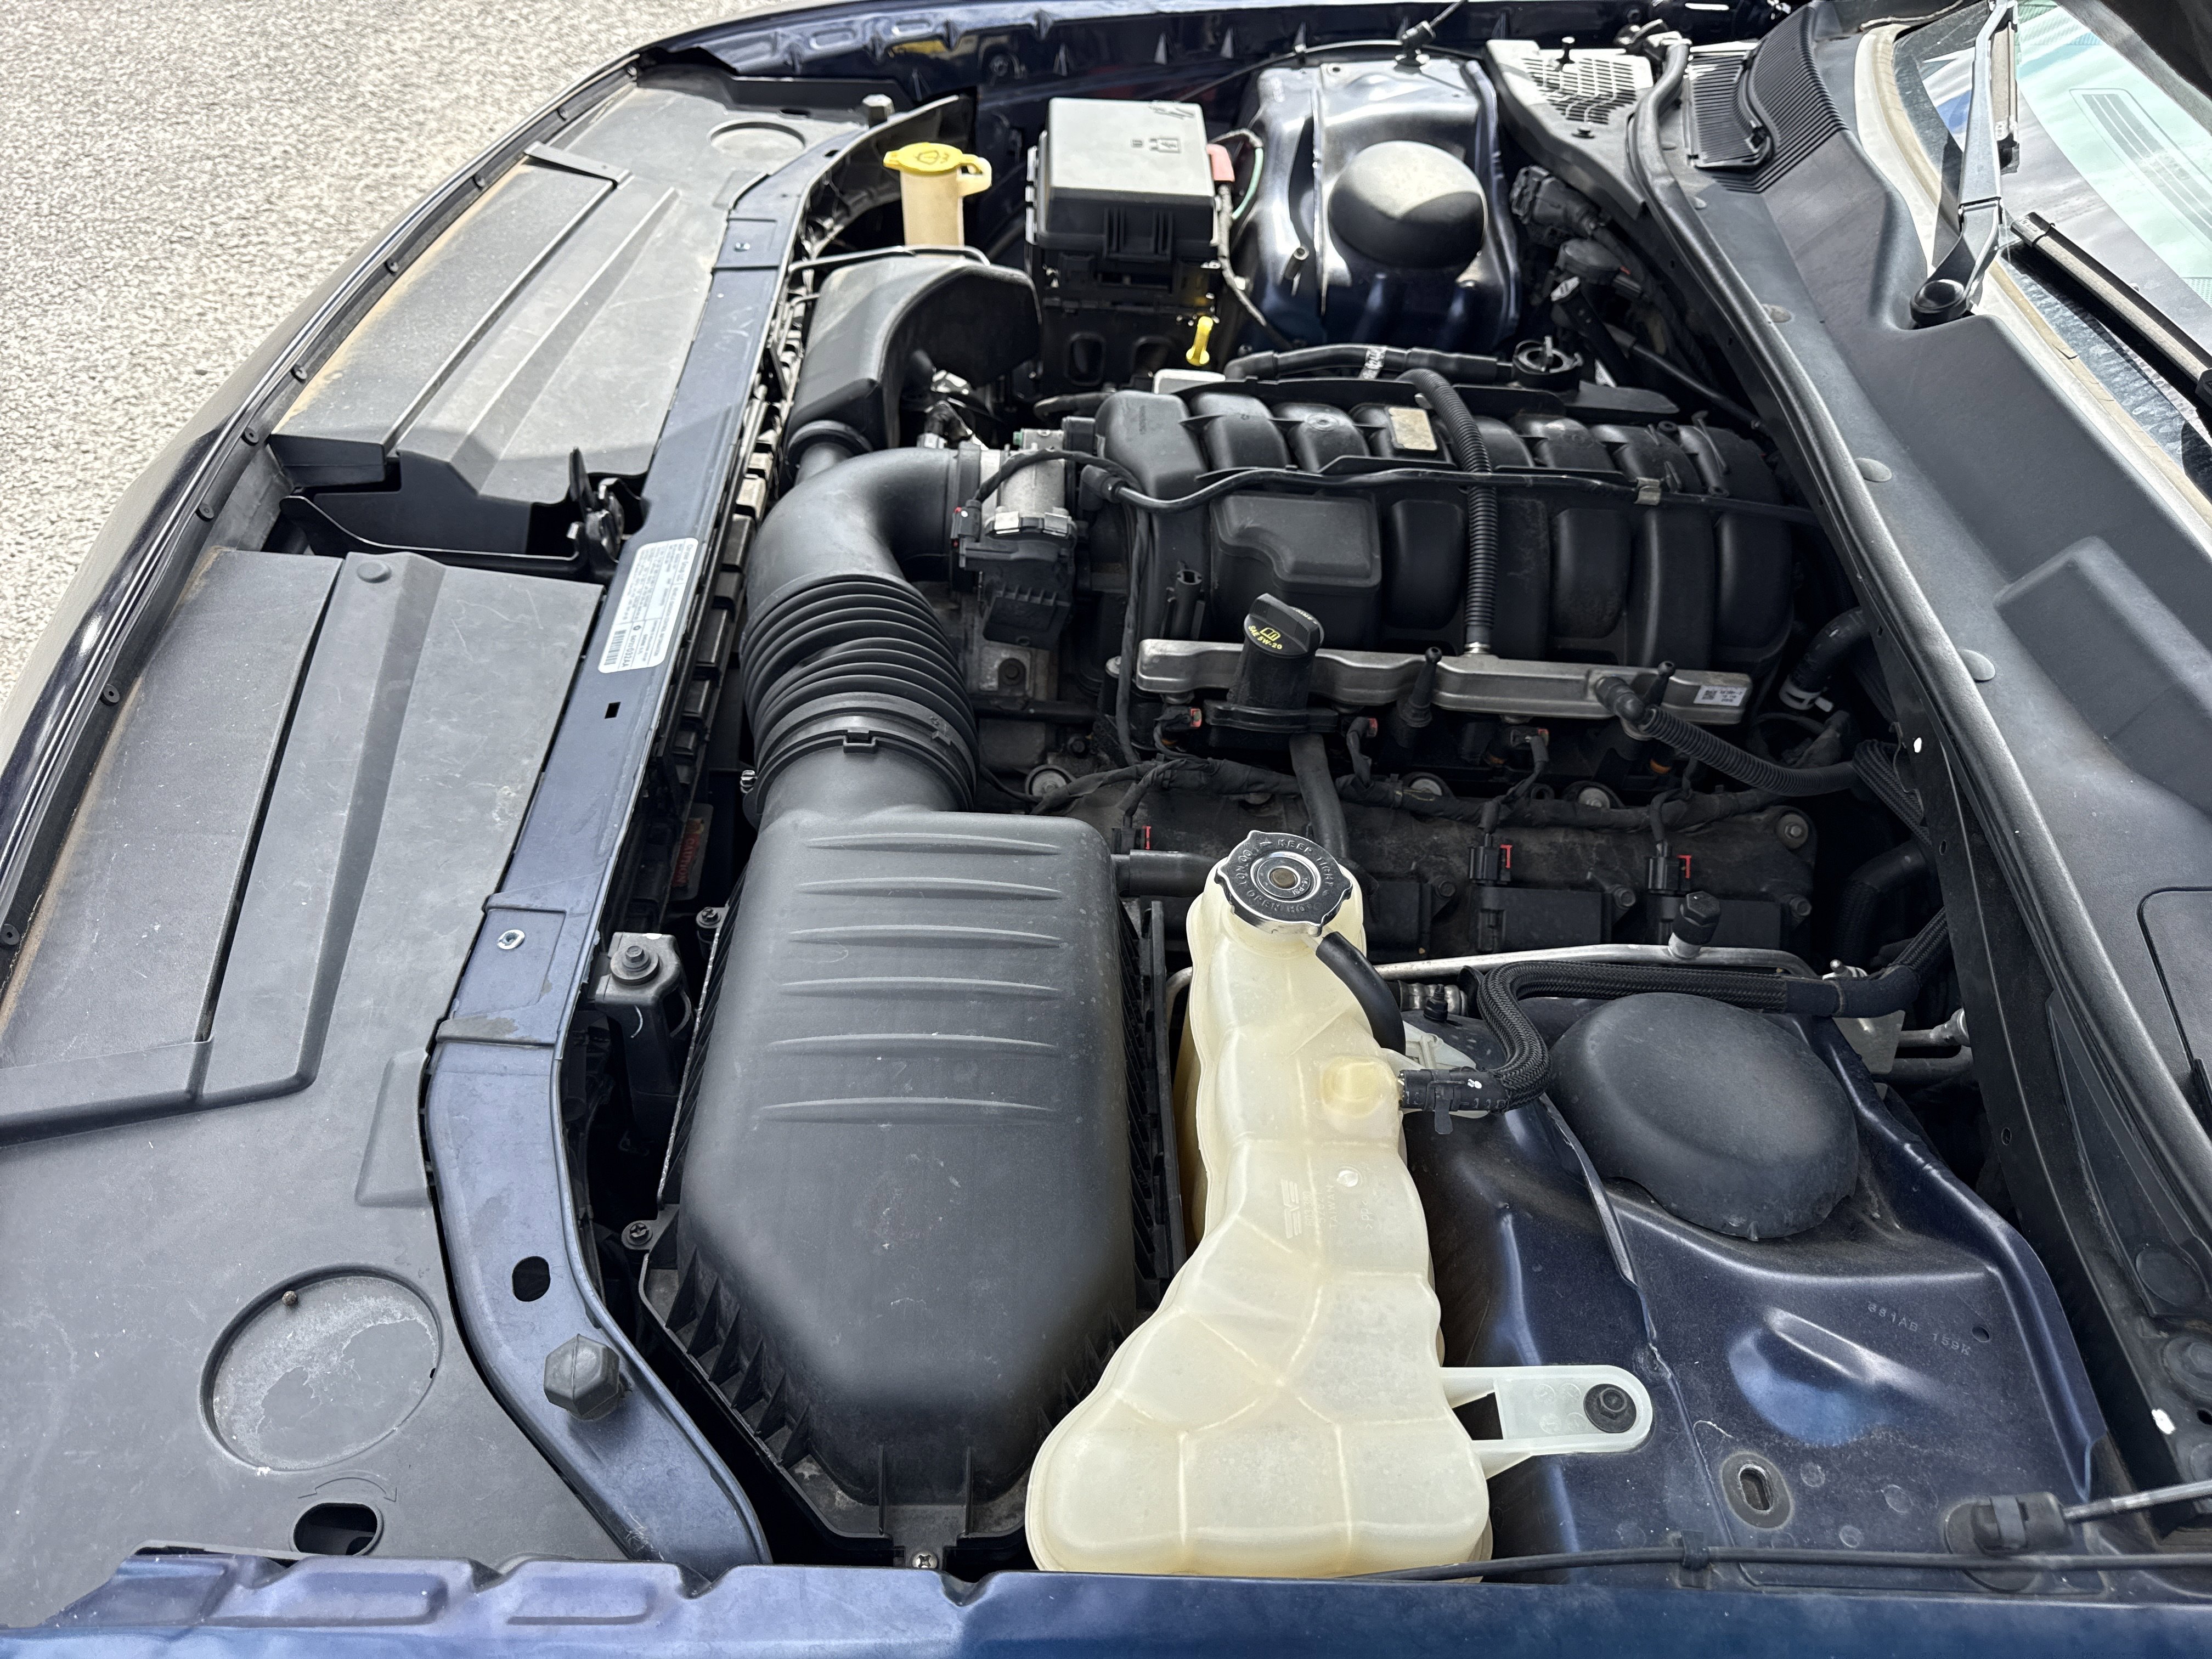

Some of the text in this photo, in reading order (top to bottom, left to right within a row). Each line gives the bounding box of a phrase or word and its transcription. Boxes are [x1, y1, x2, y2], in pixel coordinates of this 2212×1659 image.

[1248, 625, 1283, 650] SAE 5W-20
[675, 838, 695, 883] CAUTION
[1278, 839, 1334, 887] KEEP TIGHT
[1246, 890, 1282, 912] OPEN
[1286, 902, 1313, 913] HOT
[1325, 1184, 1338, 1229] TAIWAN
